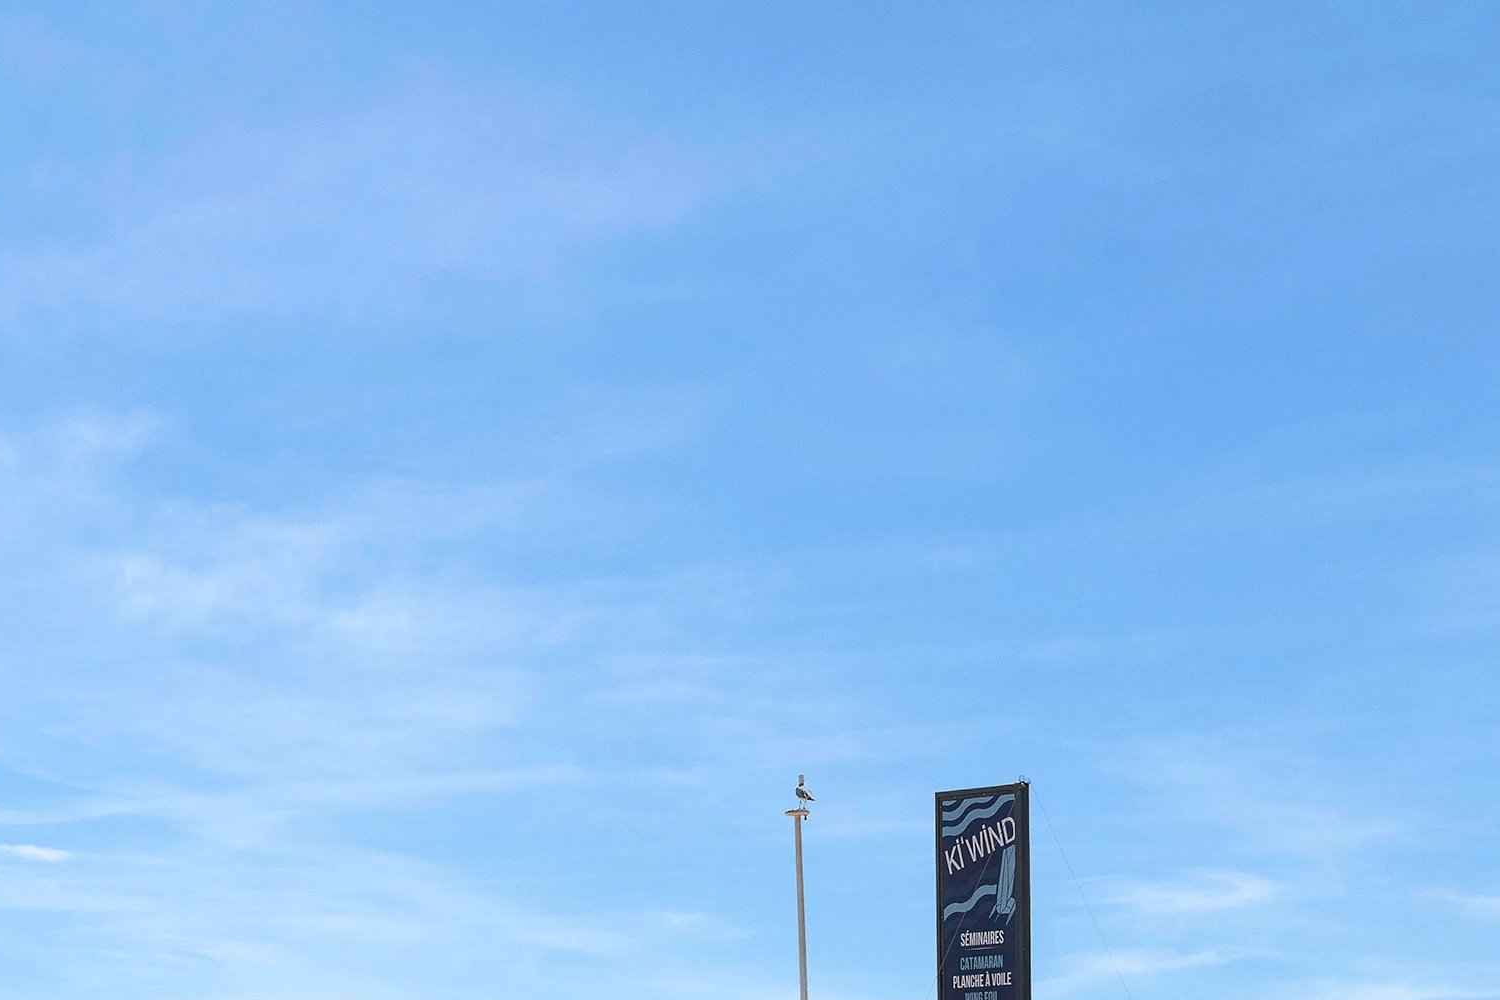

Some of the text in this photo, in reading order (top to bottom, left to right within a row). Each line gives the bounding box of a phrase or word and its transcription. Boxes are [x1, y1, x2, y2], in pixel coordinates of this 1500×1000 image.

[960, 929, 1005, 947] SÉMINAIRES
[960, 954, 1004, 971] CATAMARAN
[952, 970, 1012, 989] PLANCHE À VOILE
